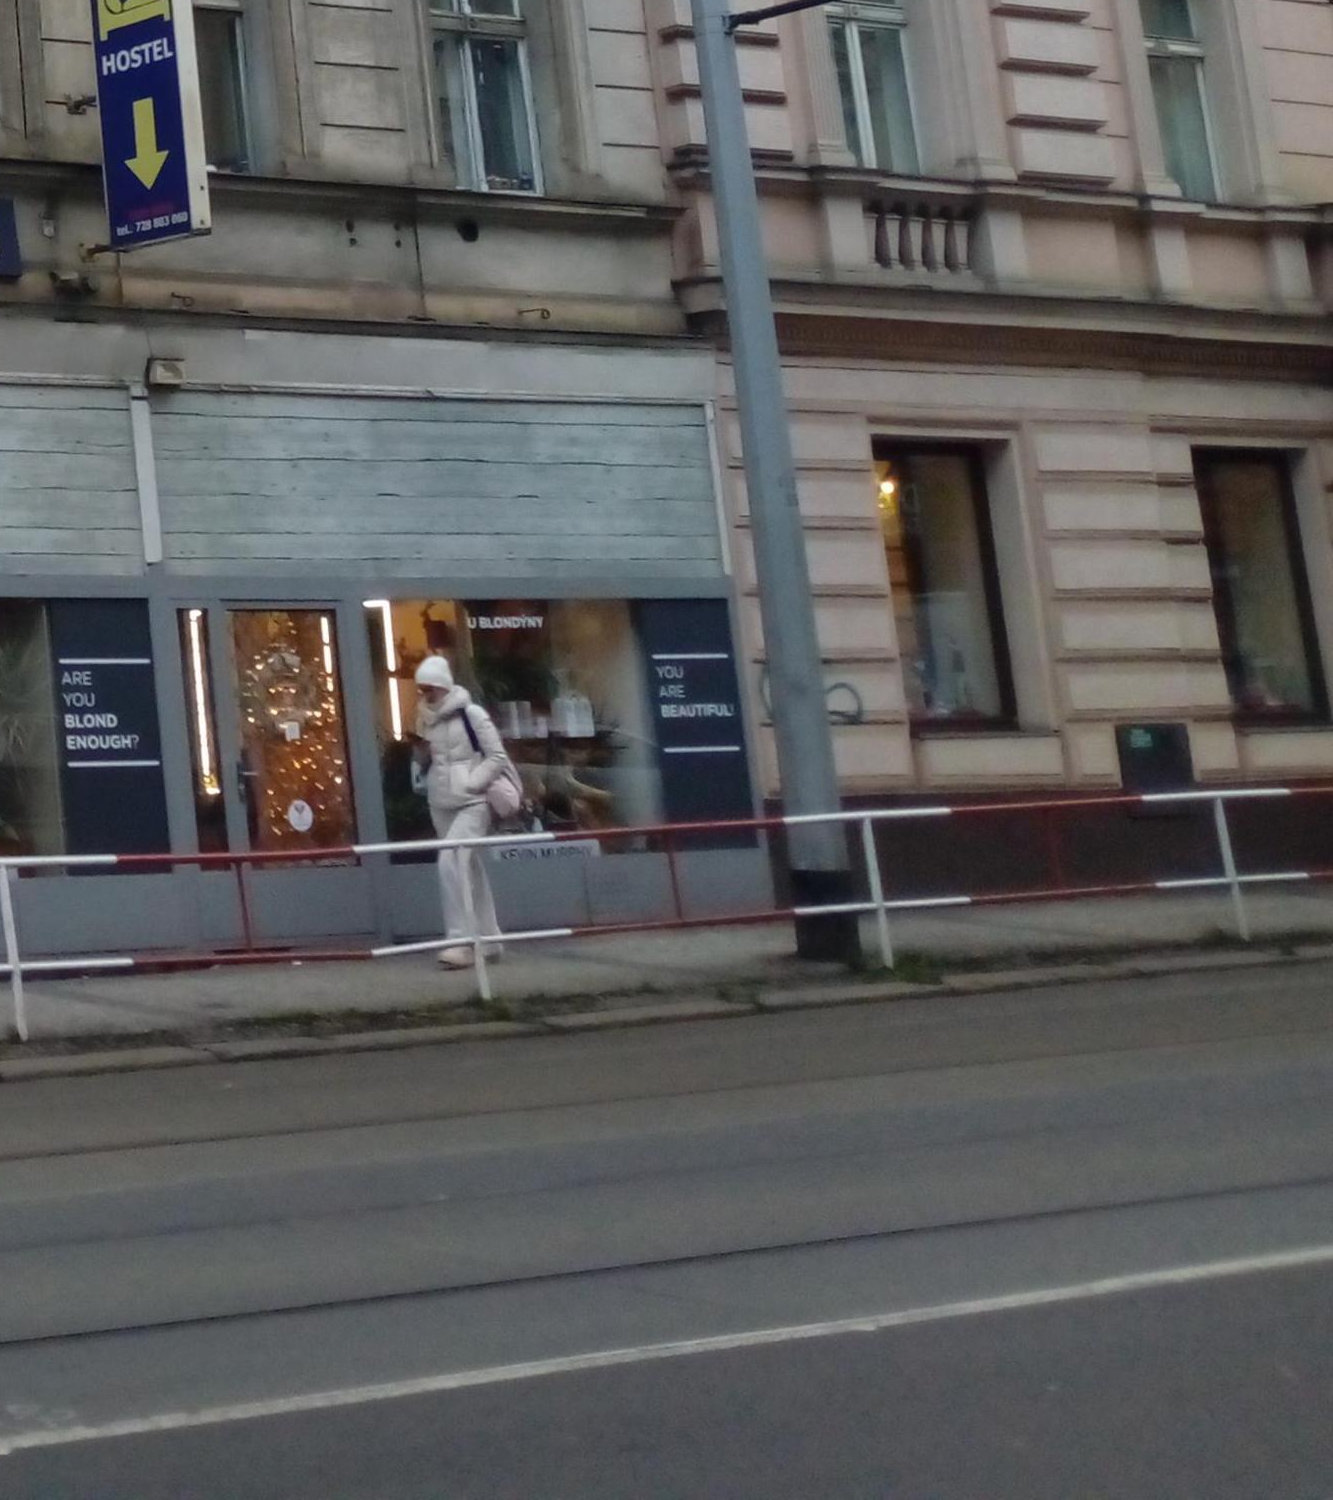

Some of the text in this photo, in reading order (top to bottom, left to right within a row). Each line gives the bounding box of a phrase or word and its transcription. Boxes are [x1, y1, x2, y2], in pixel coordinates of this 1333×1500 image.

[101, 37, 174, 77] HOSTEL
[467, 613, 544, 629] U BLONDÝNY
[61, 671, 93, 686] ARE
[655, 665, 685, 679] YOU
[659, 684, 686, 698] ARE
[62, 692, 96, 707] YOU
[660, 703, 735, 718] BEAUTIFUL!
[64, 713, 119, 729] BLOND
[65, 734, 140, 750] ENOUGH?
